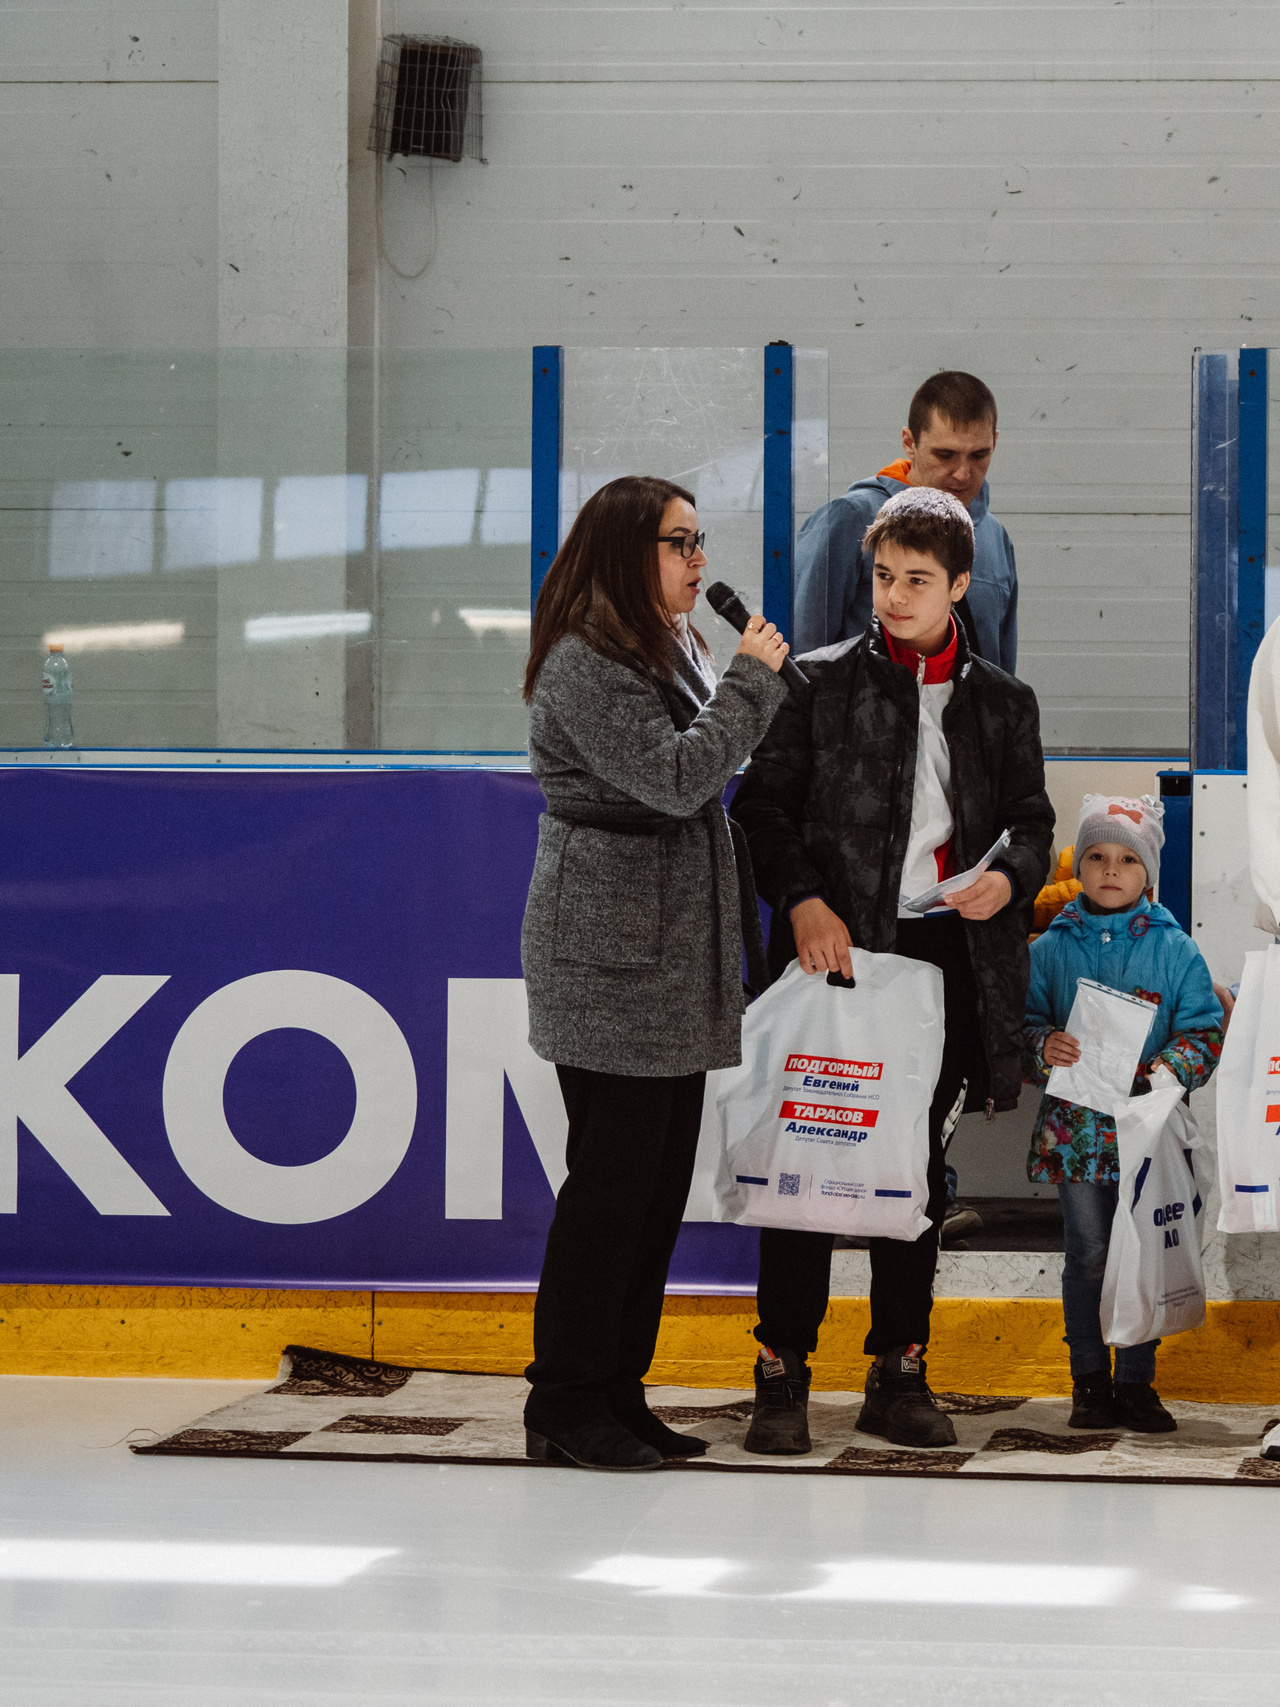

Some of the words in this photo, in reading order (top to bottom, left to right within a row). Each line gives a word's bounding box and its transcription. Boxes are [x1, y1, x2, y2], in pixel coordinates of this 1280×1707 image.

[788, 1058, 880, 1078] ПОДГОРНЫЙ
[802, 1075, 860, 1092] Евгений
[793, 1104, 863, 1123] ТАРАСОВ
[785, 1121, 868, 1143] Александр
